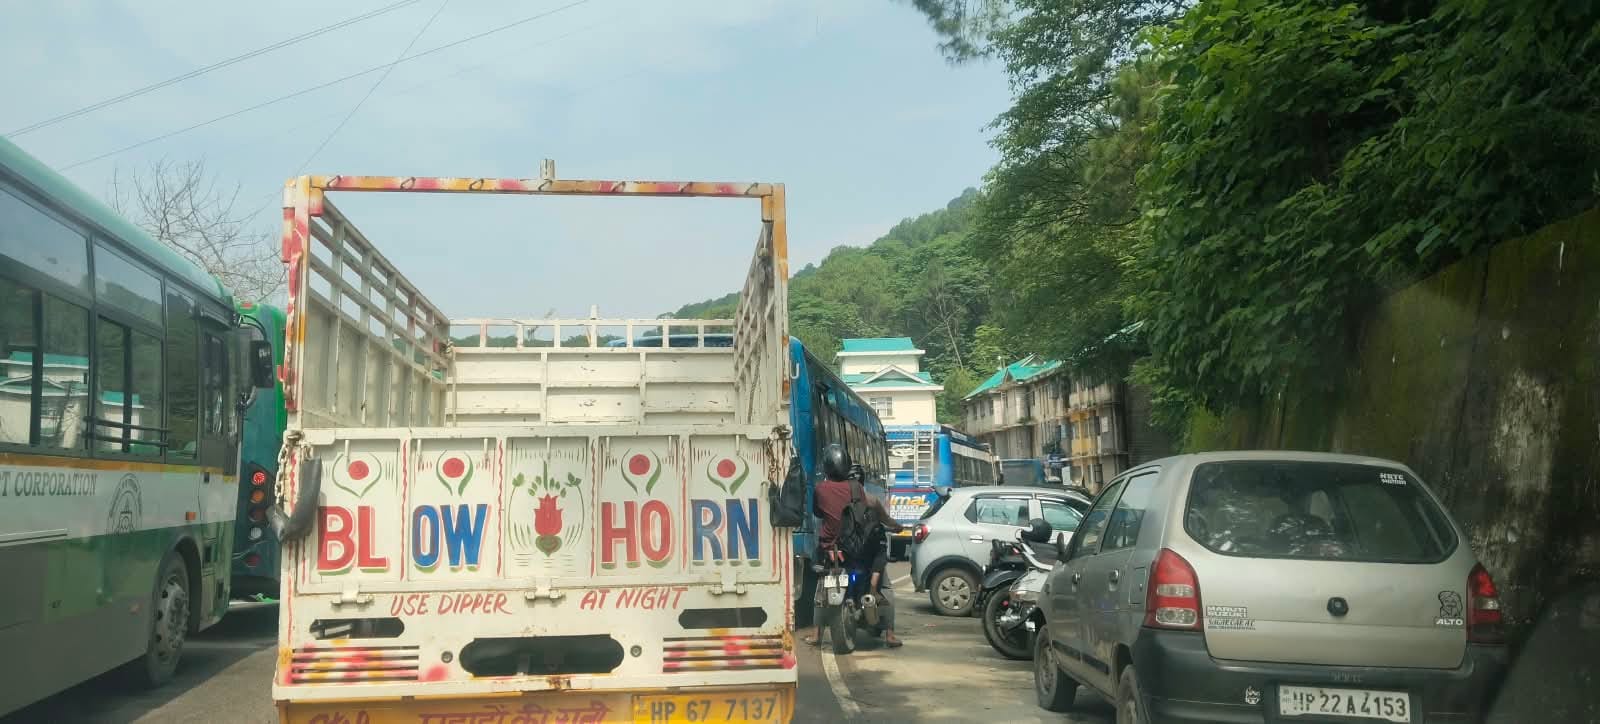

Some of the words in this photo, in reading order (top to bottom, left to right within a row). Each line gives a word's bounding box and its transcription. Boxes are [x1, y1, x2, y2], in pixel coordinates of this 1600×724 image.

[14, 471, 98, 497] CORPORATION
[390, 594, 429, 616] USE
[437, 592, 513, 616] DIPPER
[579, 588, 610, 611] AT
[615, 586, 689, 610] NIGHT
[1207, 611, 1248, 619] SUZUKI
[1435, 618, 1464, 626] ALTO
[651, 700, 676, 722] HP
[686, 700, 711, 723] 67
[724, 697, 777, 722] 7137
[1293, 691, 1315, 712] HP
[1319, 693, 1341, 714] 22
[1346, 695, 1356, 715] A
[1361, 691, 1406, 718] 4153
